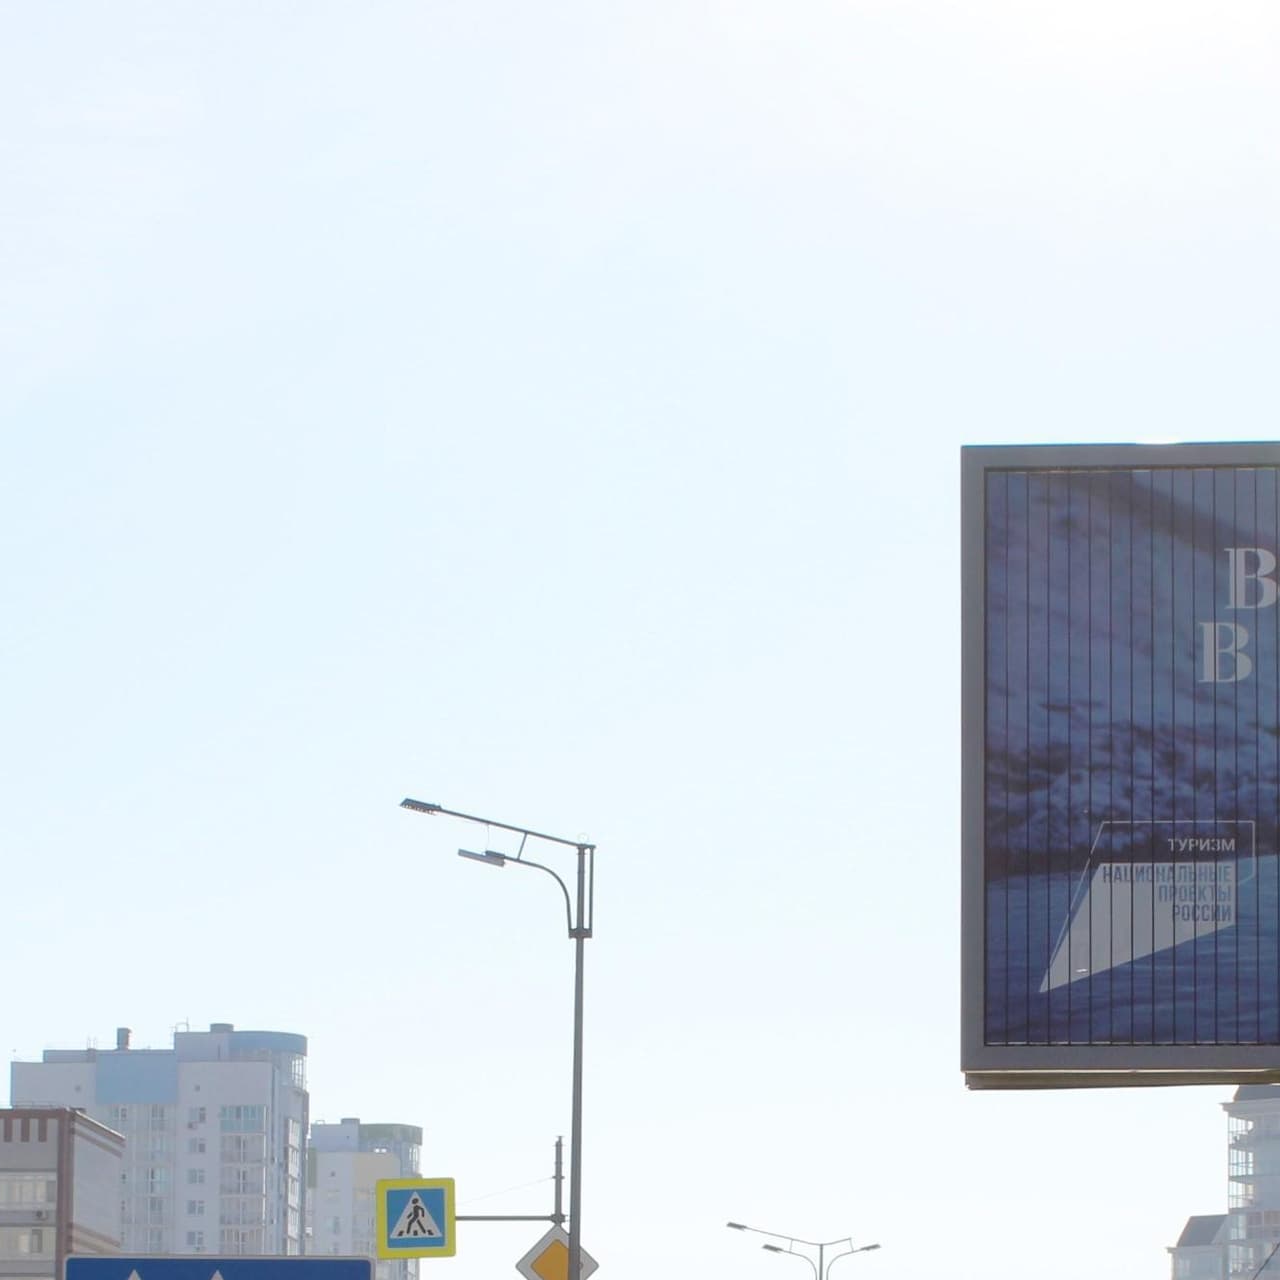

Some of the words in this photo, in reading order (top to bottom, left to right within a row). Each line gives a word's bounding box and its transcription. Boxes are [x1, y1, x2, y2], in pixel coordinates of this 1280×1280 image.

[1198, 620, 1253, 683] В
[1167, 838, 1236, 852] ТУРИЗМ
[1158, 884, 1232, 903] ПРОЕКТЫ
[1172, 904, 1232, 922] РОССИИ
